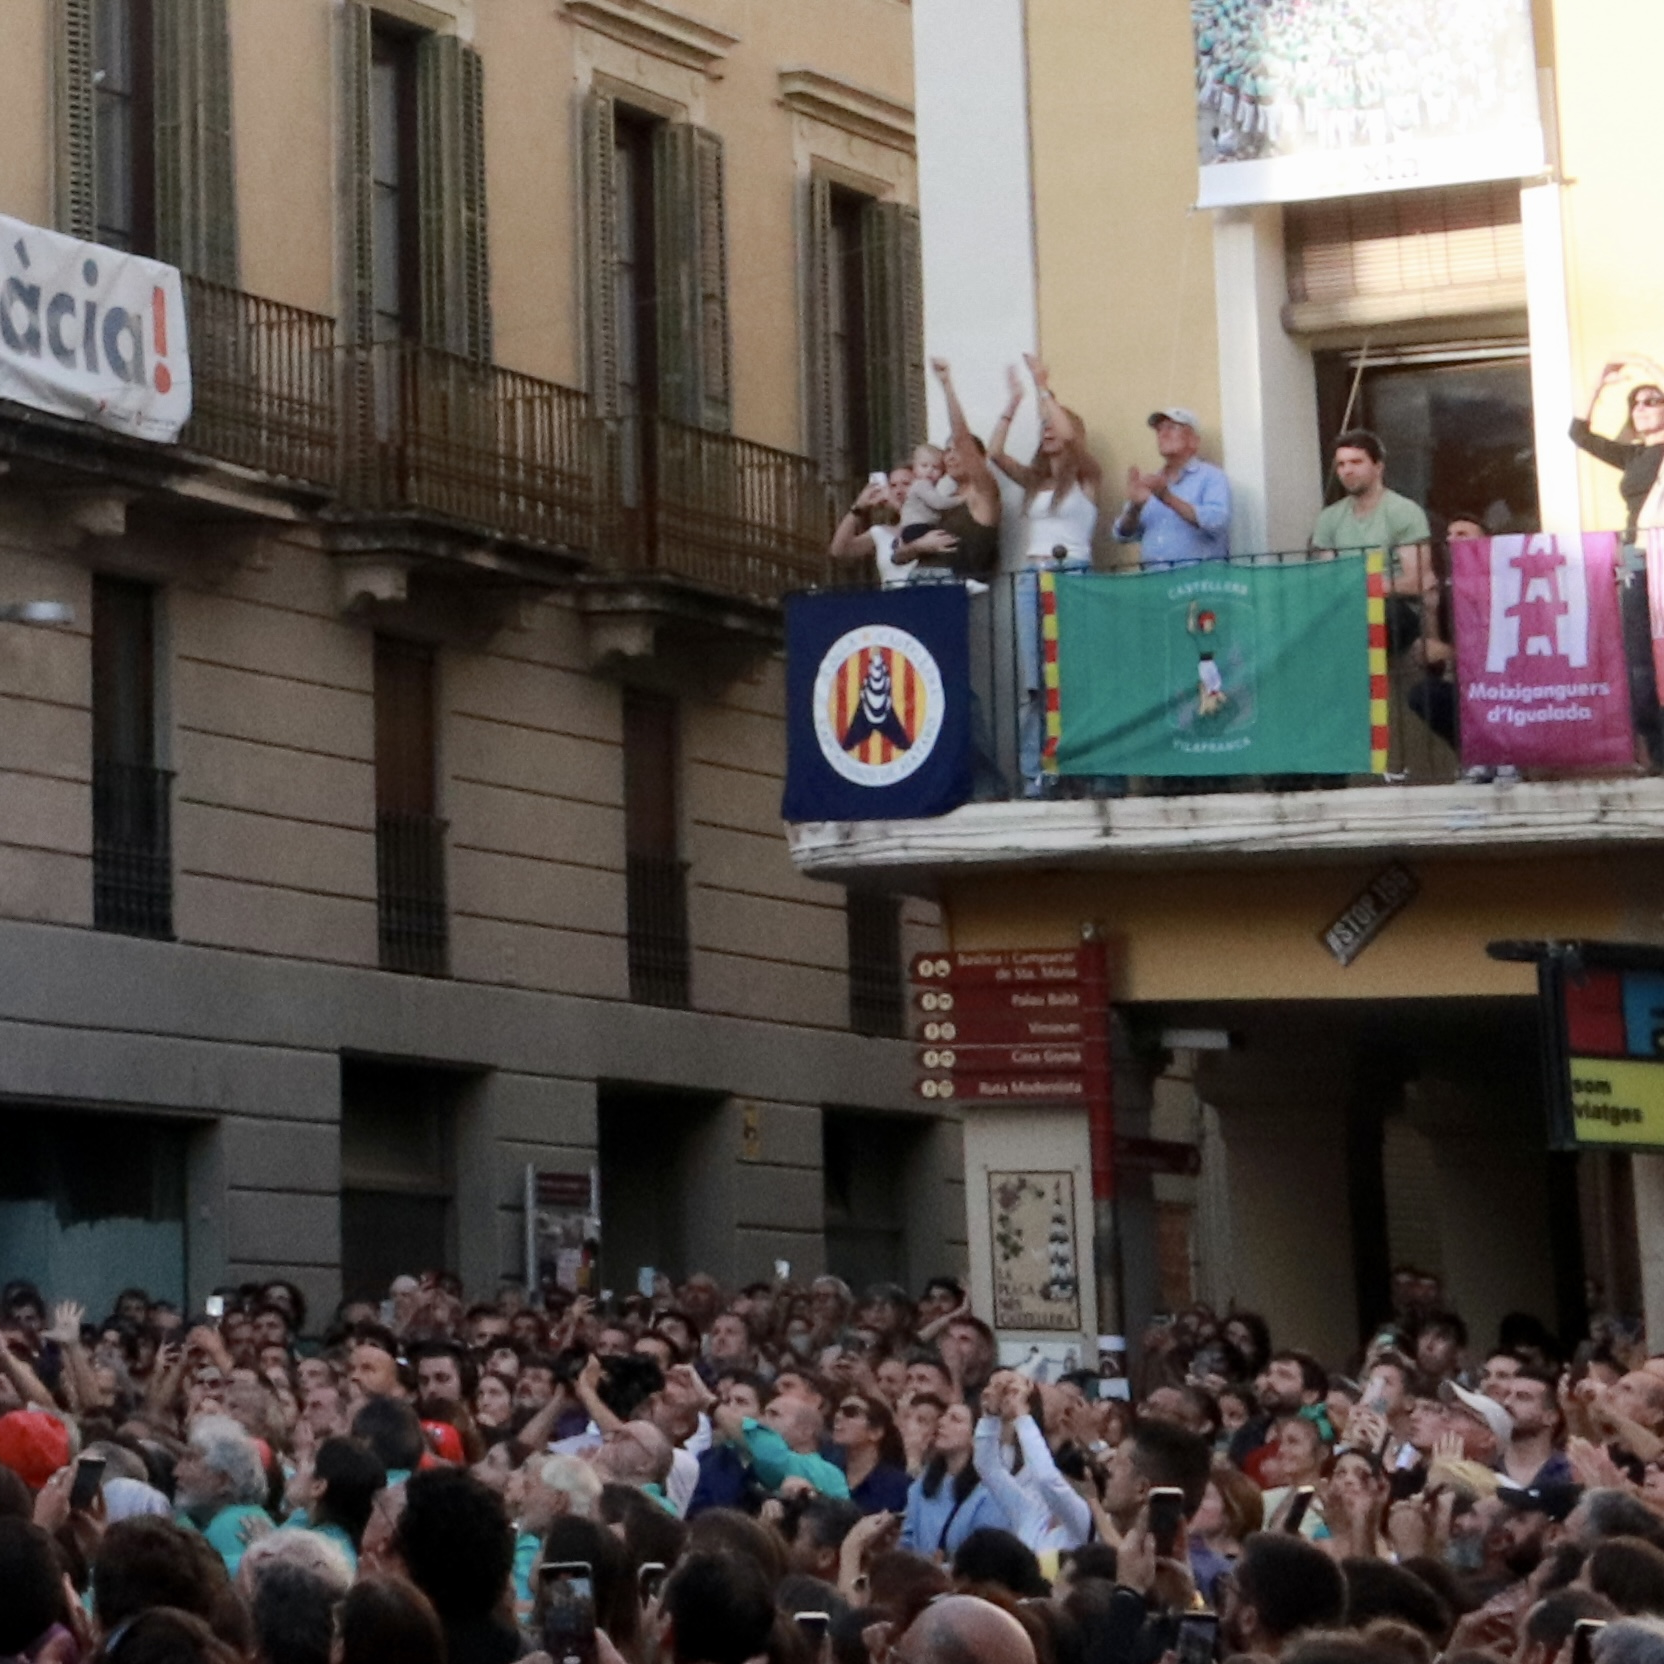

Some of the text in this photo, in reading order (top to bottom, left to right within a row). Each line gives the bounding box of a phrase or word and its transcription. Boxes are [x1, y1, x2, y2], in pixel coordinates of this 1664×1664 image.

[1168, 579, 1249, 600] CASTELLERS
[1468, 681, 1610, 703] Moixiganguers
[1487, 702, 1592, 727] d'Igualada
[1573, 1100, 1645, 1126] viatges
